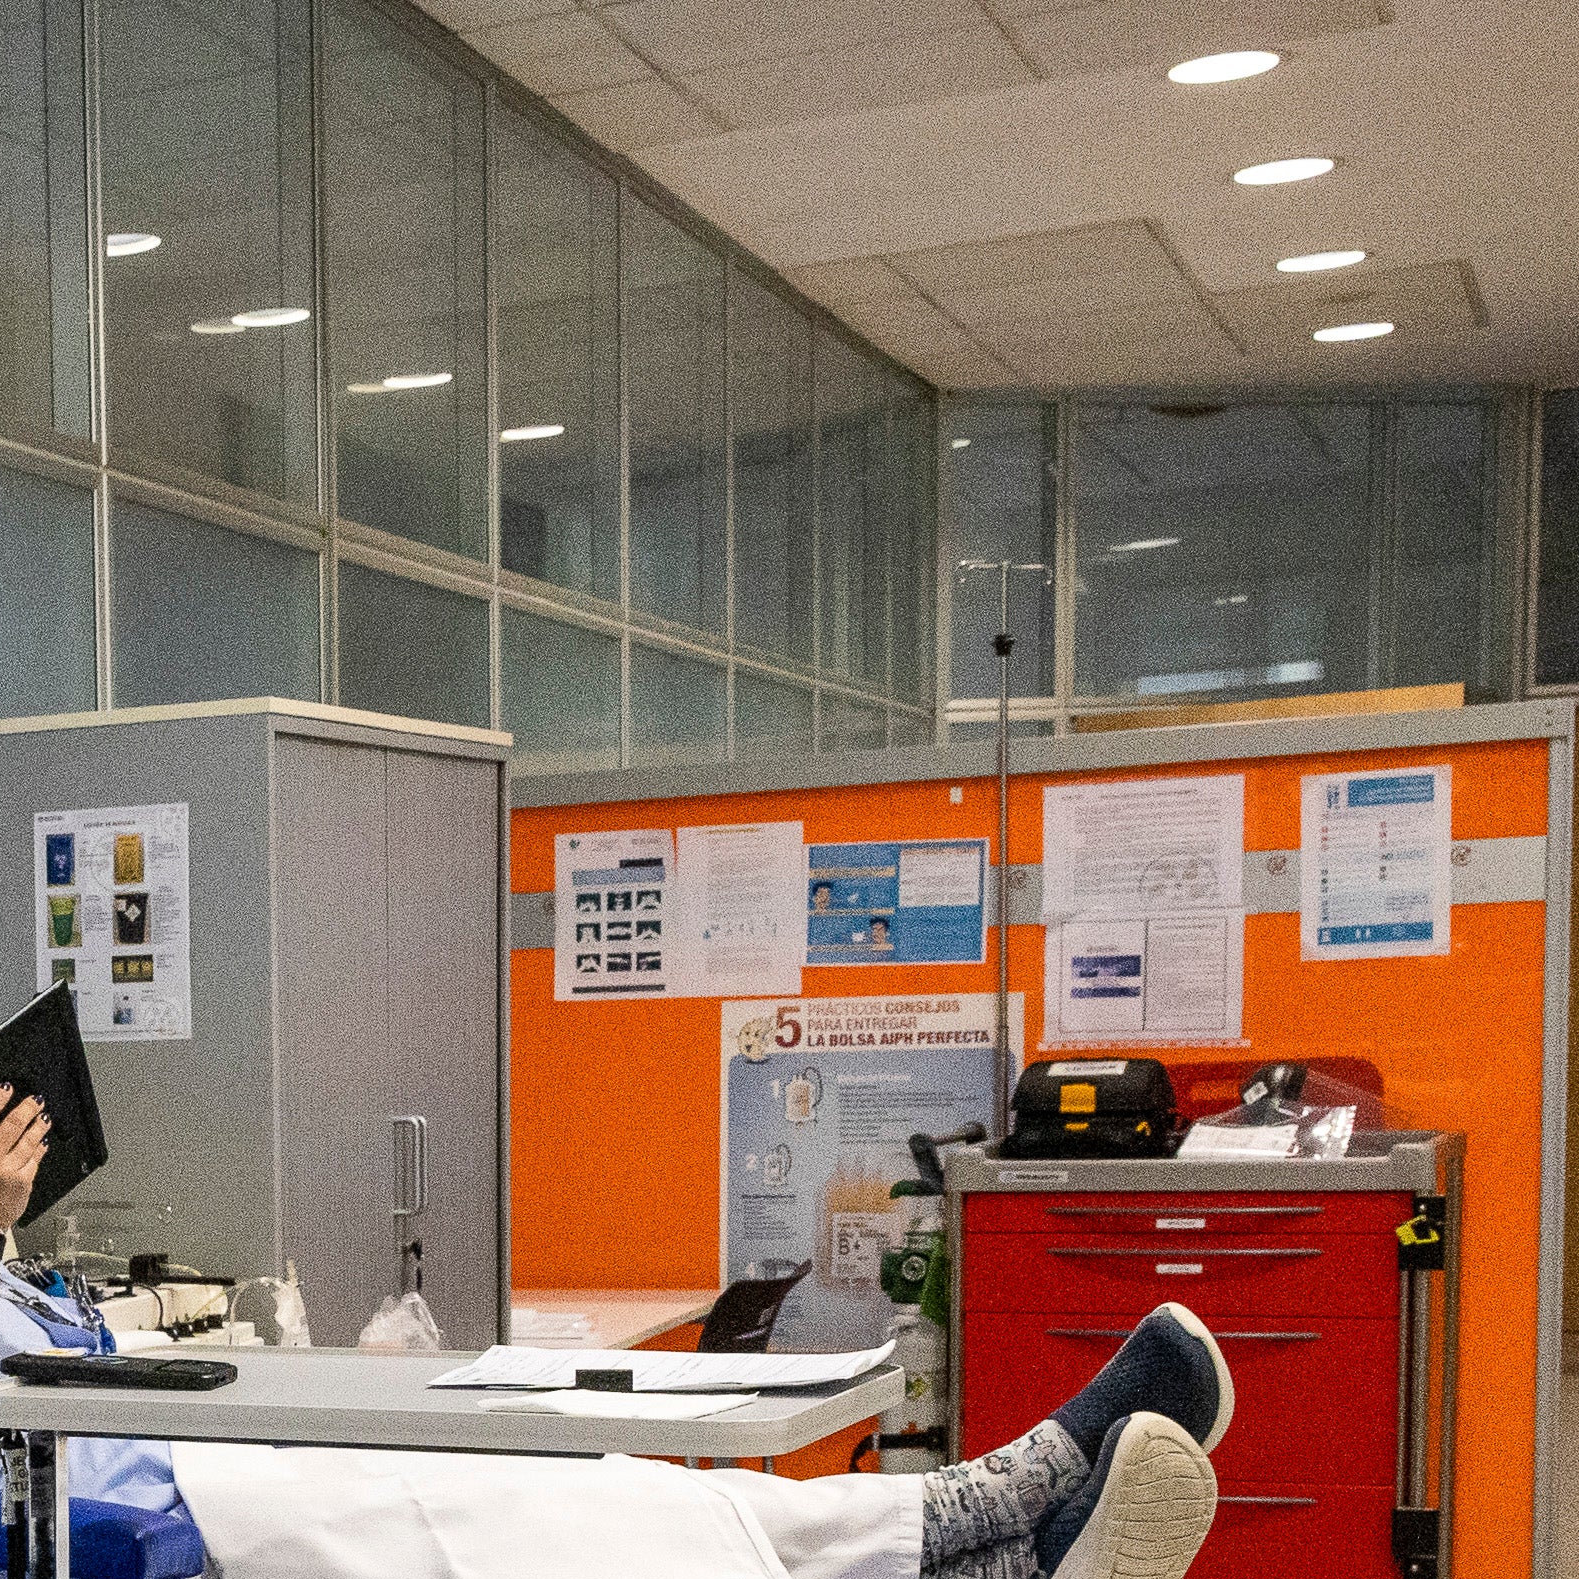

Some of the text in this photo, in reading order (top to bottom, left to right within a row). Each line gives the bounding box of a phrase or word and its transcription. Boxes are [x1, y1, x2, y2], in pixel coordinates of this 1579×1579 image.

[885, 1000, 961, 1016] CONSEJOS
[773, 1006, 803, 1049] 5
[807, 1015, 918, 1032] PARA ENTREGAR
[807, 1034, 826, 1047] LA
[829, 1032, 876, 1047] BOLSA
[916, 1029, 991, 1044] PERFECTA
